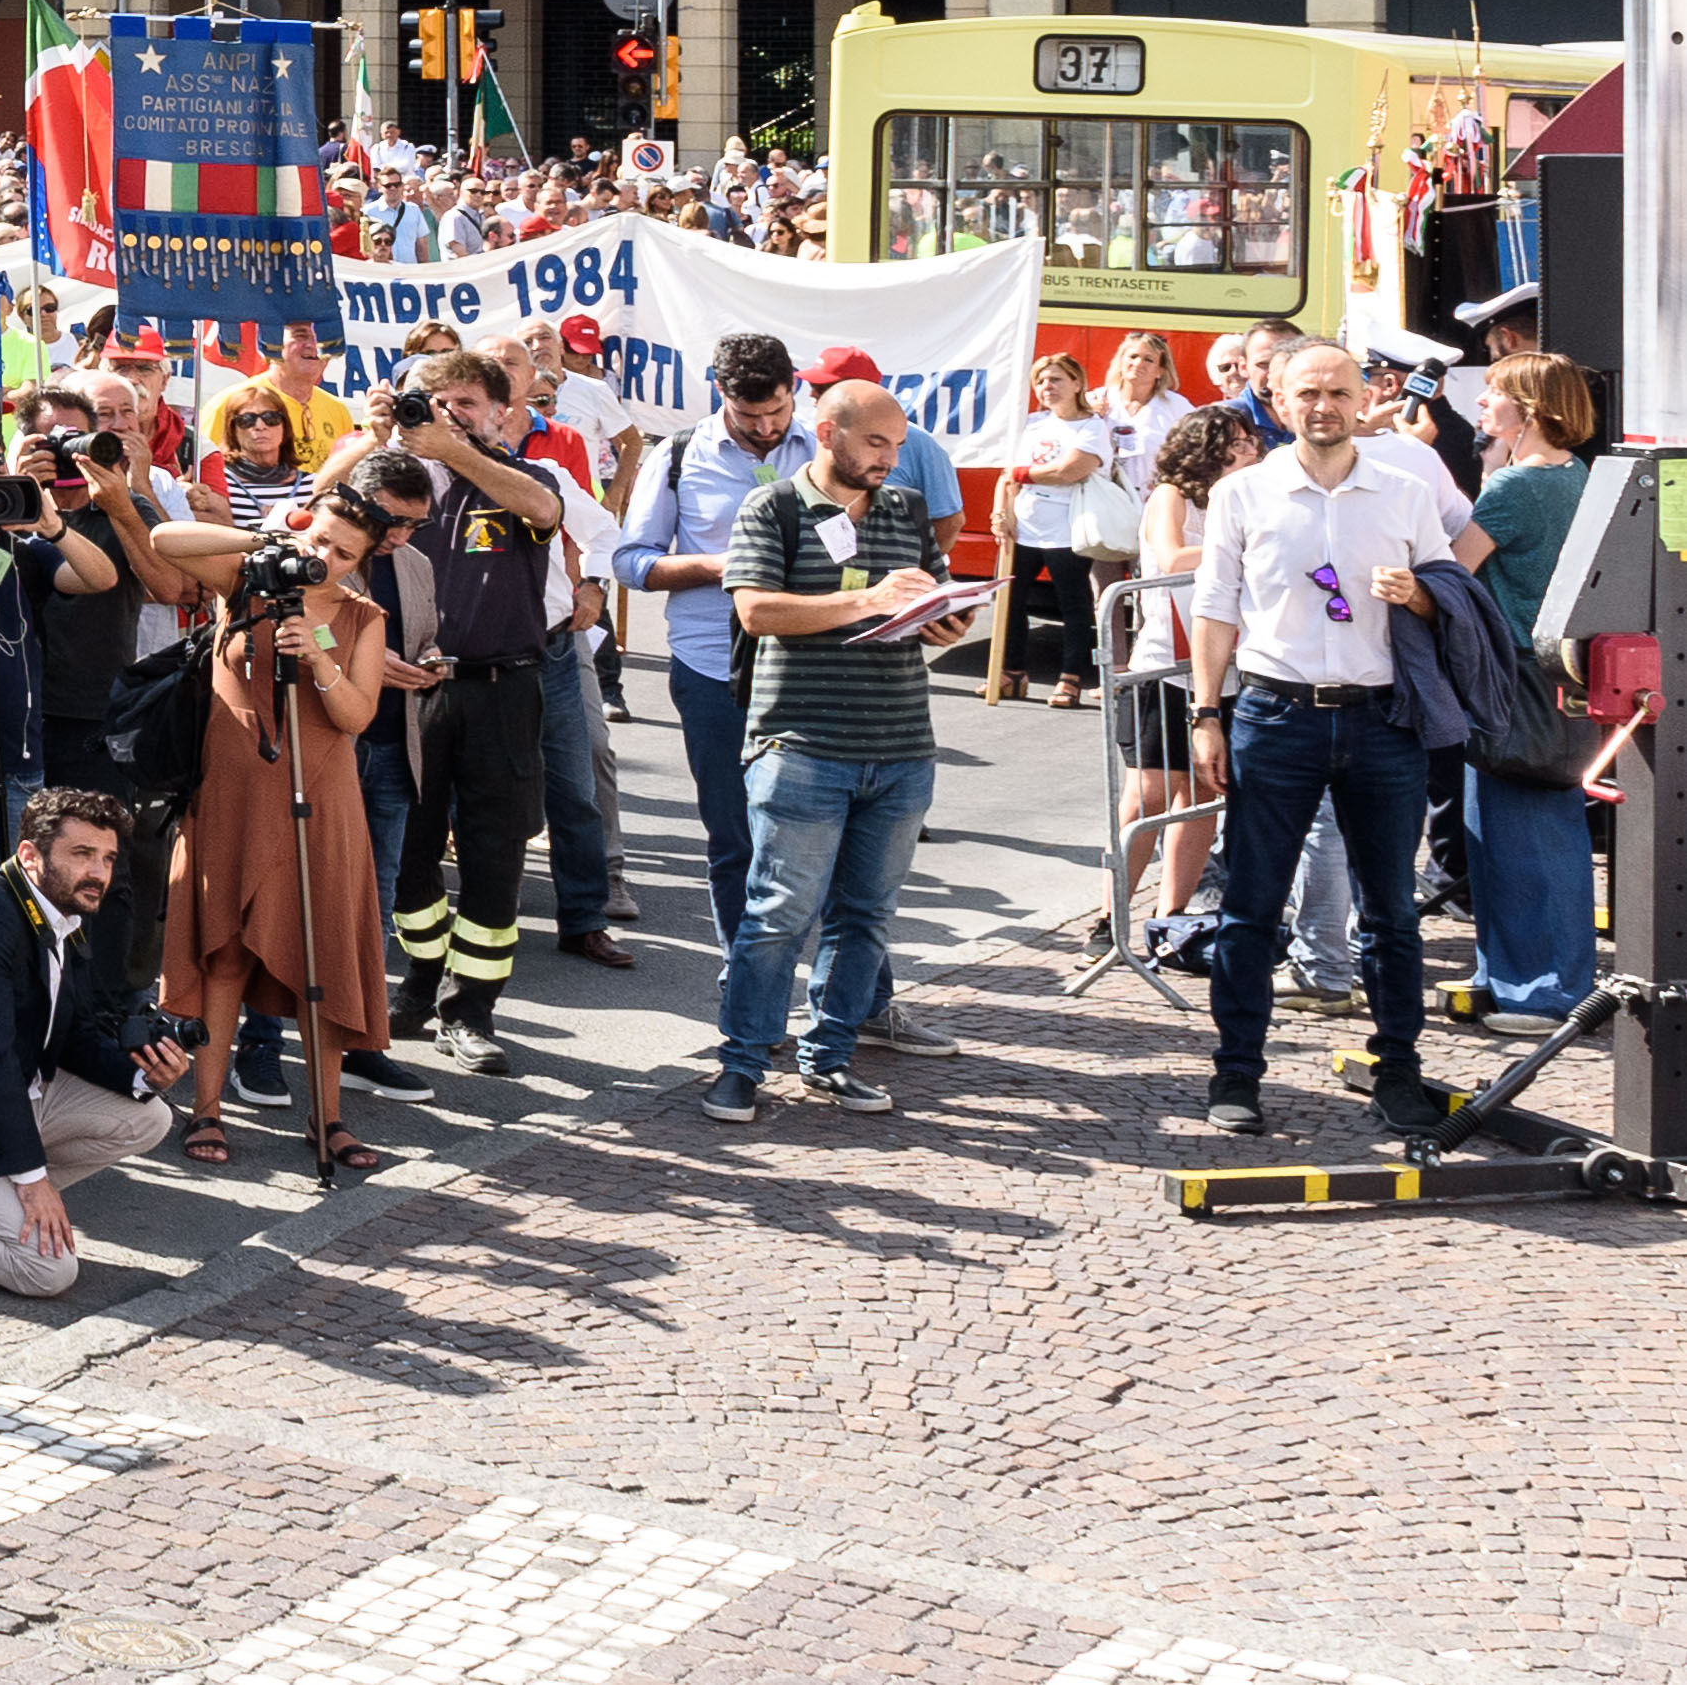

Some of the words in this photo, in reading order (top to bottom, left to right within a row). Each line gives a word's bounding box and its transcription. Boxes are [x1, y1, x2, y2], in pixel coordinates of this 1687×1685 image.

[203, 51, 257, 72] ANPI
[1059, 45, 1111, 84] 37
[142, 95, 242, 115] PARTIGIANI
[123, 115, 210, 133] COMITATO
[338, 278, 481, 325] mbre
[508, 239, 638, 318] 1984
[1073, 275, 1175, 292] "TRENTASETTE"
